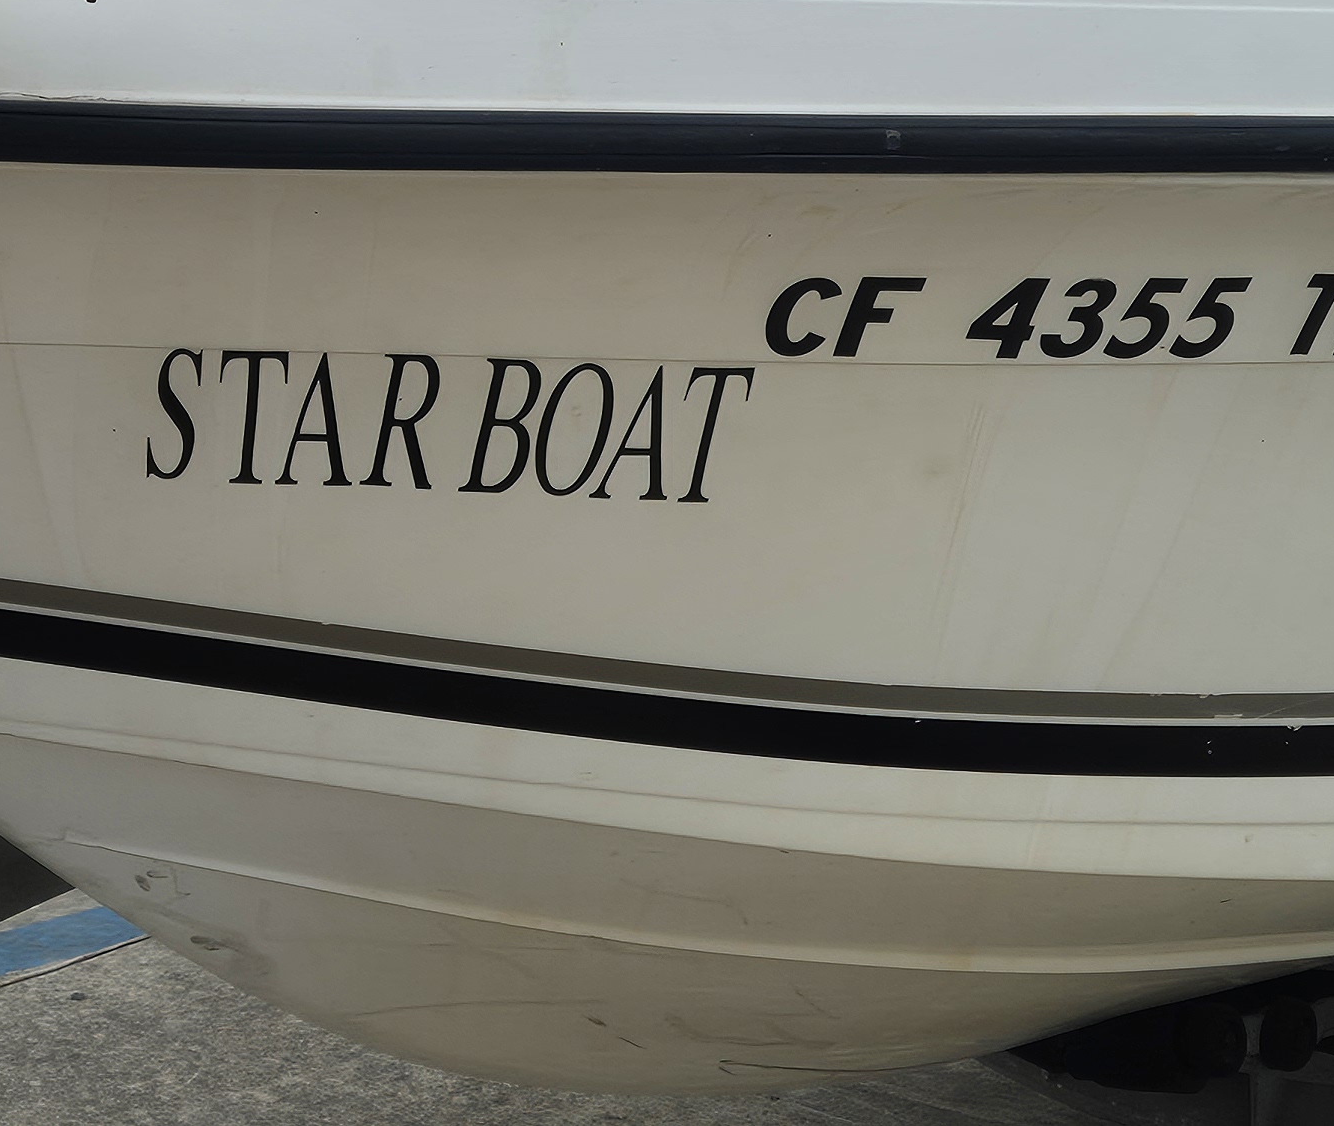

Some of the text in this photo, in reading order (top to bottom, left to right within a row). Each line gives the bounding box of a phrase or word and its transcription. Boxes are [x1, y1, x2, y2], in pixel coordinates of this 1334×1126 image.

[764, 275, 928, 358] CF
[965, 276, 1254, 360] 4355
[146, 348, 756, 504] STAR BOAT
